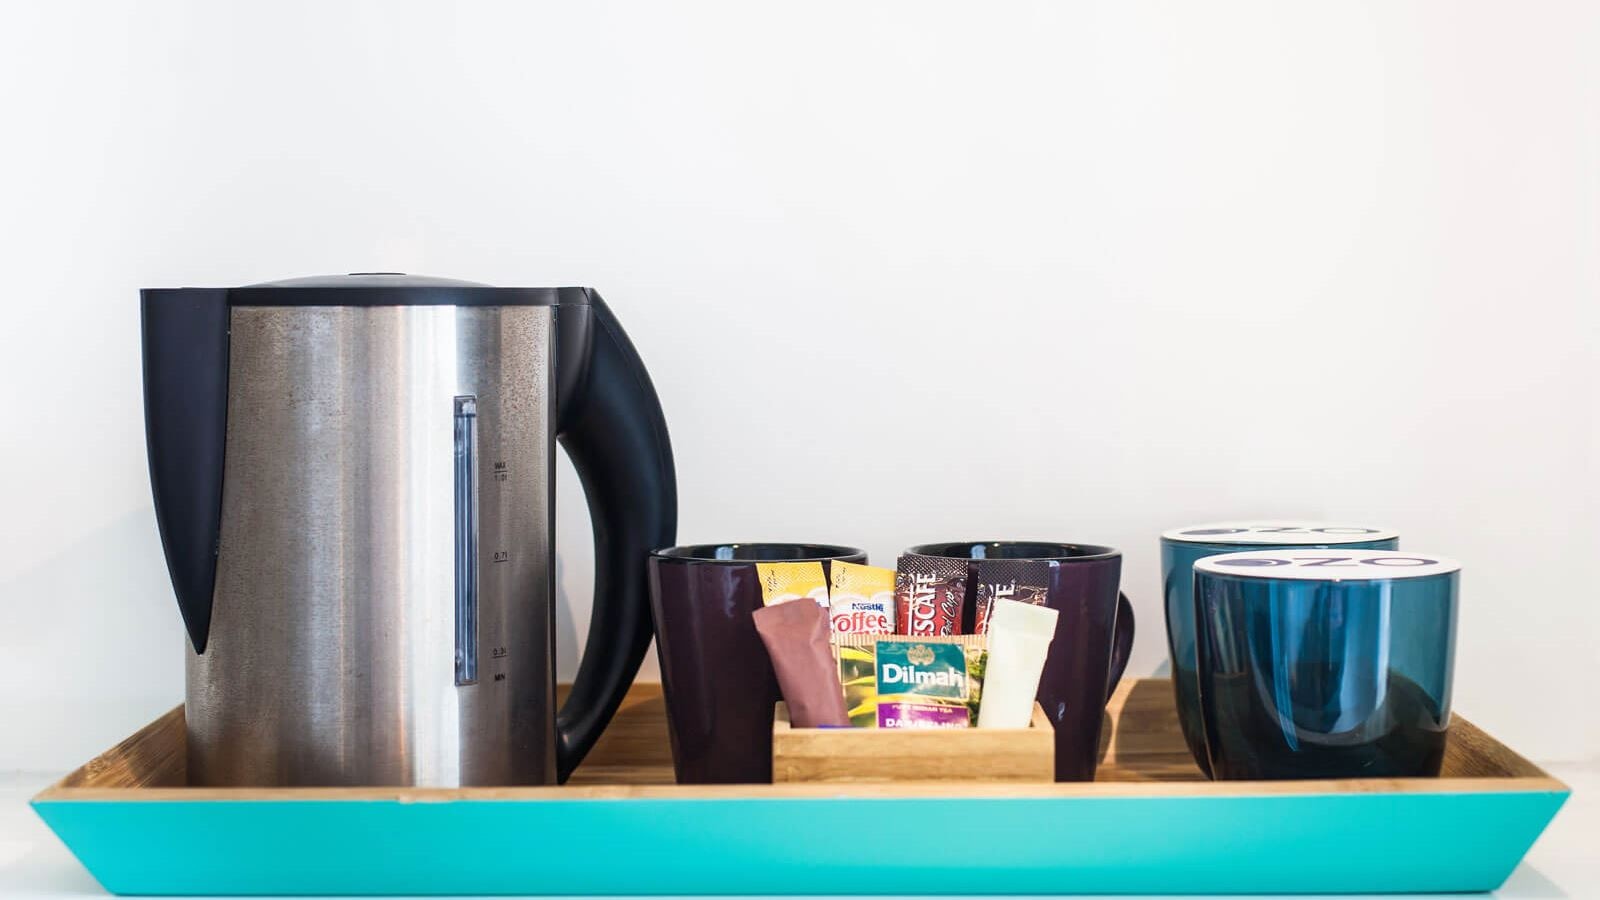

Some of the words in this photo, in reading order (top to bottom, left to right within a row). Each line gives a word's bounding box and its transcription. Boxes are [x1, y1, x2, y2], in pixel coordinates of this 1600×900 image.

[1179, 527, 1381, 536] OZO
[1213, 557, 1439, 567] OZO
[940, 591, 957, 617] Cup
[882, 663, 964, 688] Dilmah
